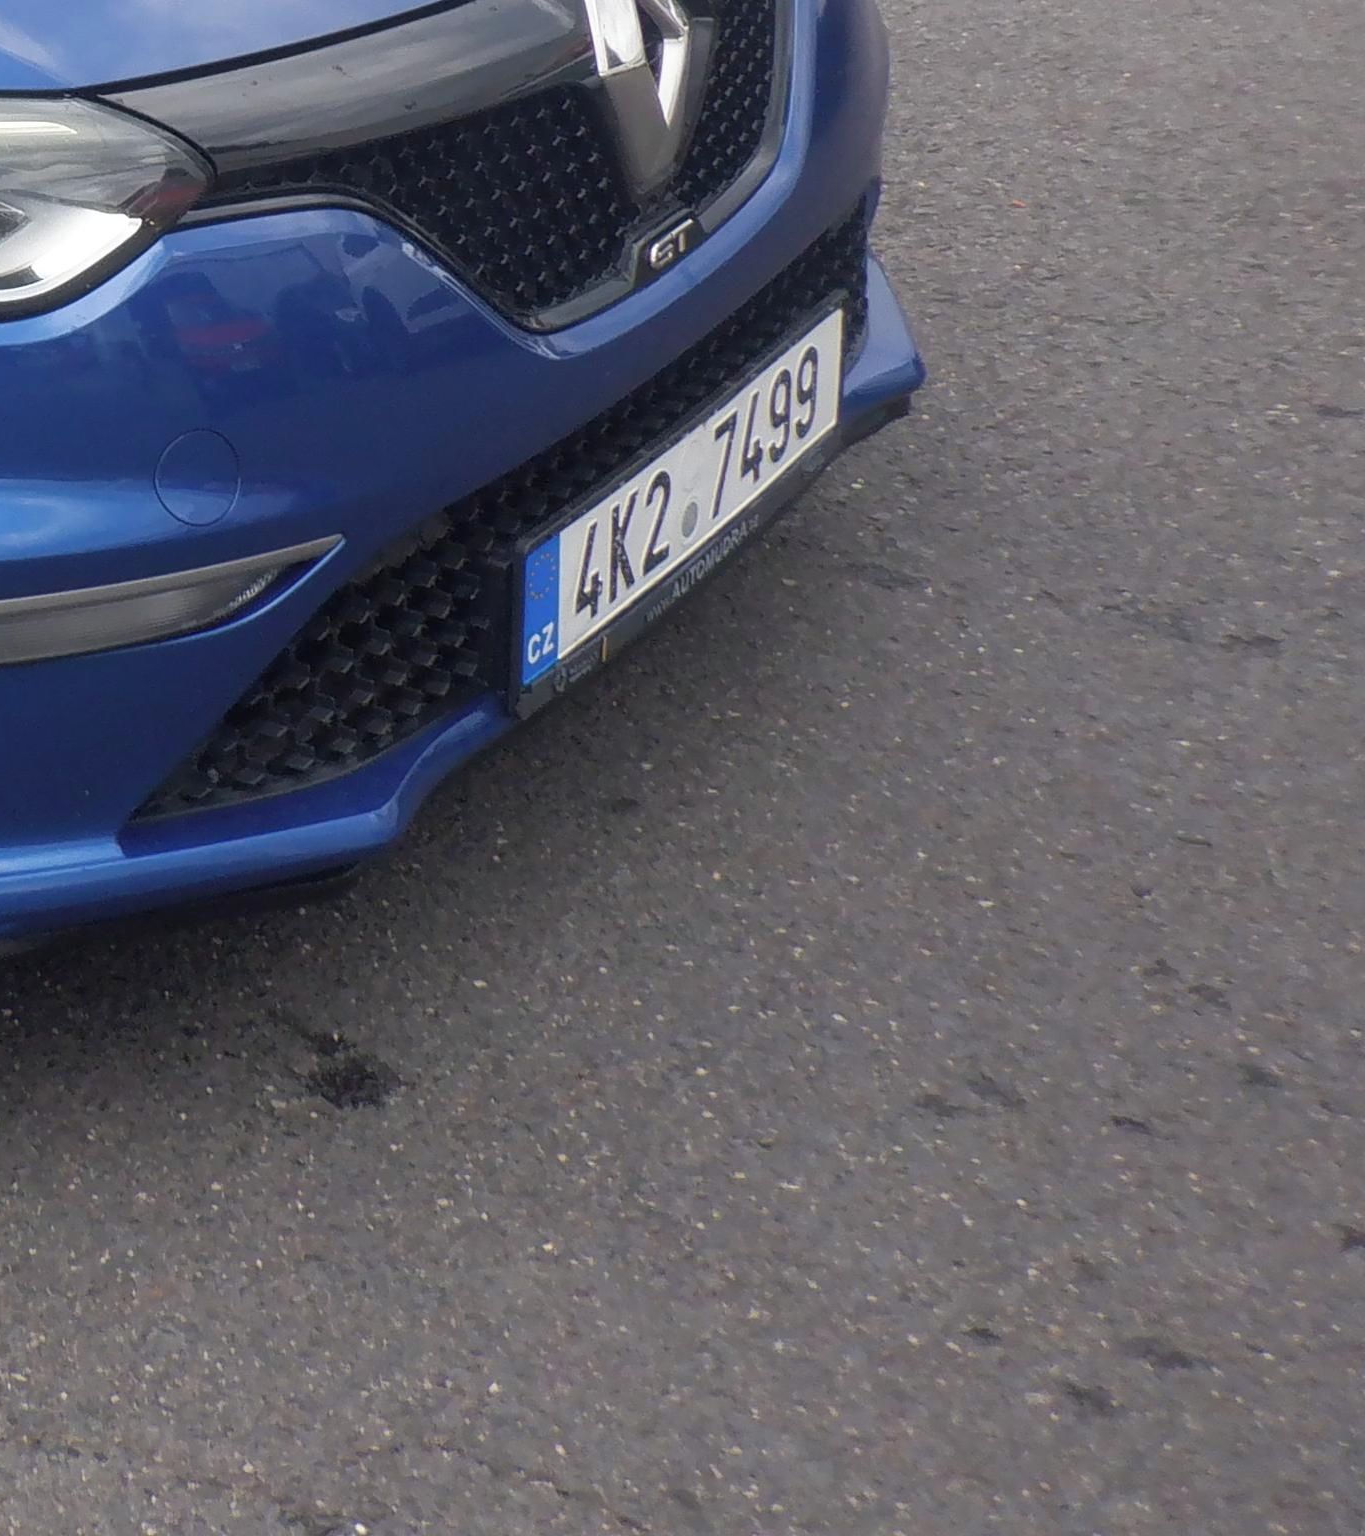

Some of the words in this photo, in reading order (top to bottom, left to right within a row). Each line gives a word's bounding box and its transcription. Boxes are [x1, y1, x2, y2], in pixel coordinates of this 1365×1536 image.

[650, 218, 694, 271] GT
[572, 470, 671, 620] 4K2
[711, 343, 820, 520] 7499
[527, 621, 555, 664] CZ
